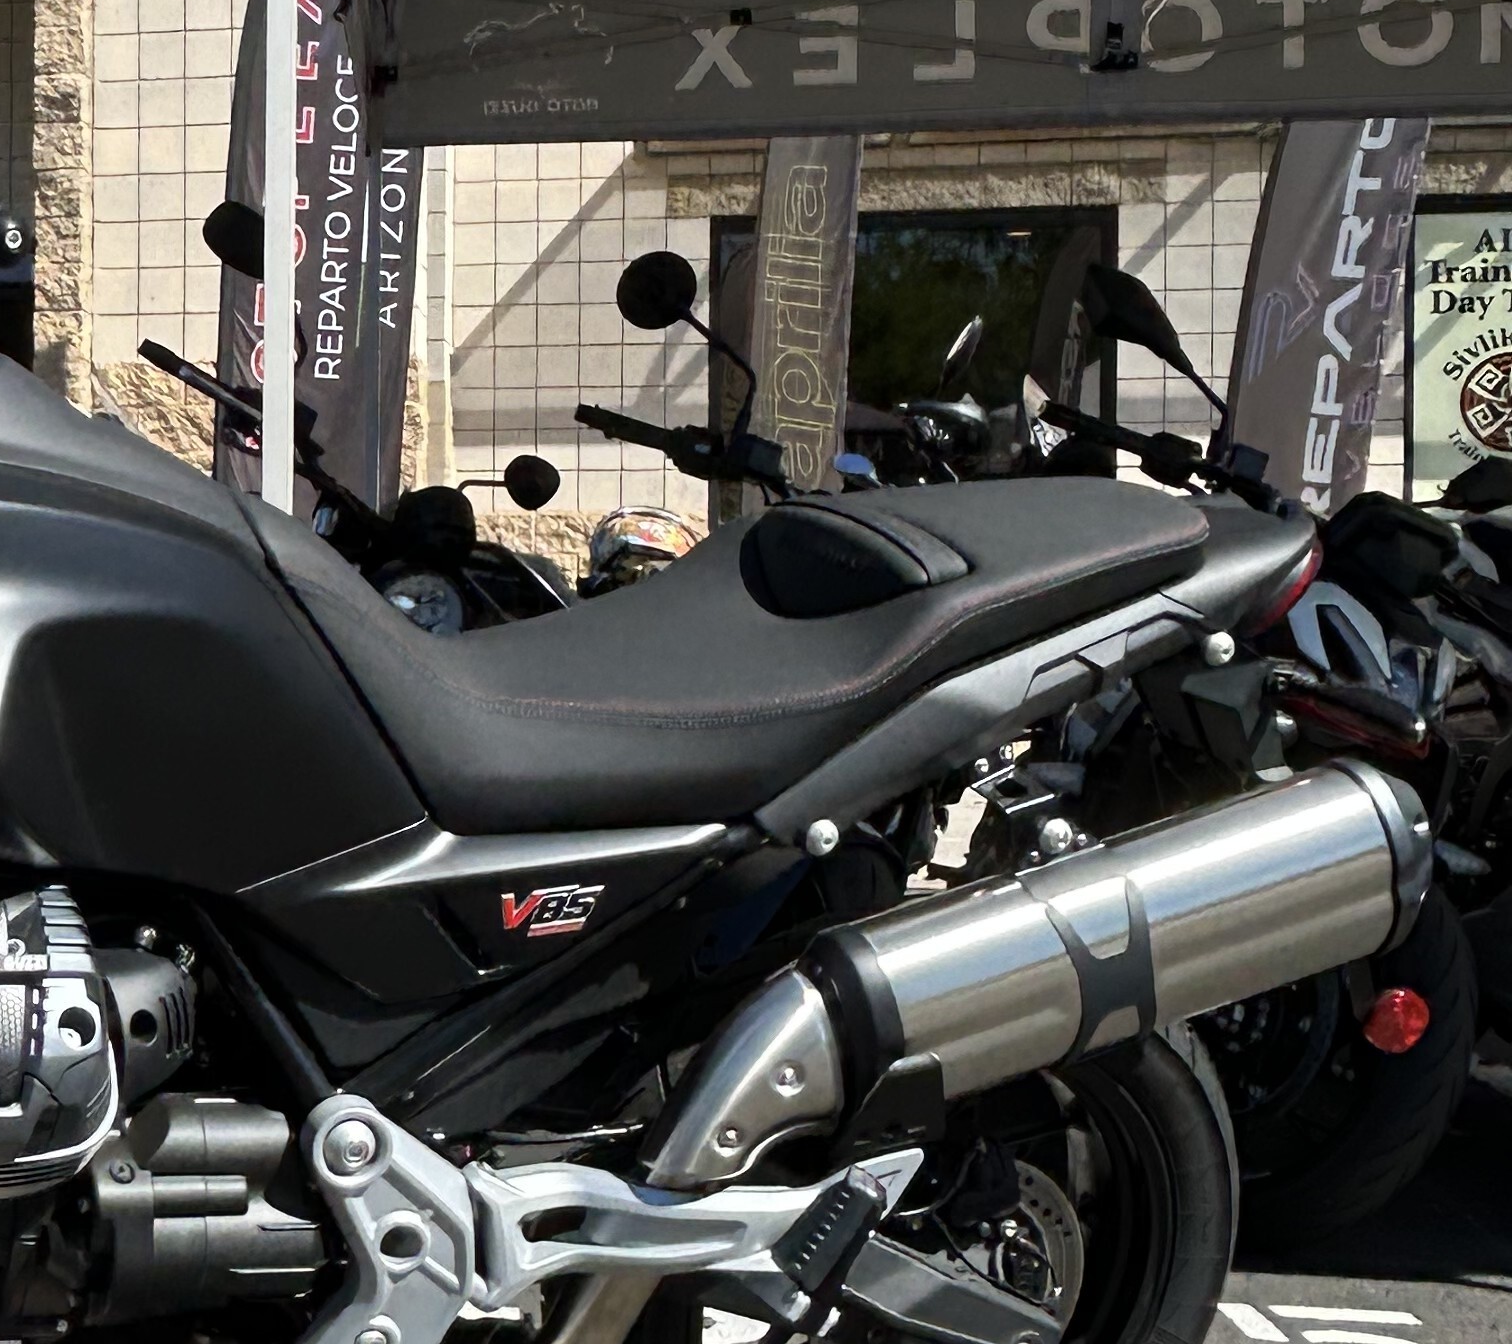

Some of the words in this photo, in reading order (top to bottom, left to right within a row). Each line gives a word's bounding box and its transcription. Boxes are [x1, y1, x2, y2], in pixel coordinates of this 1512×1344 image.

[314, 211, 352, 380] REPARTO
[1430, 289, 1495, 321] Day
[500, 884, 606, 933] V85
